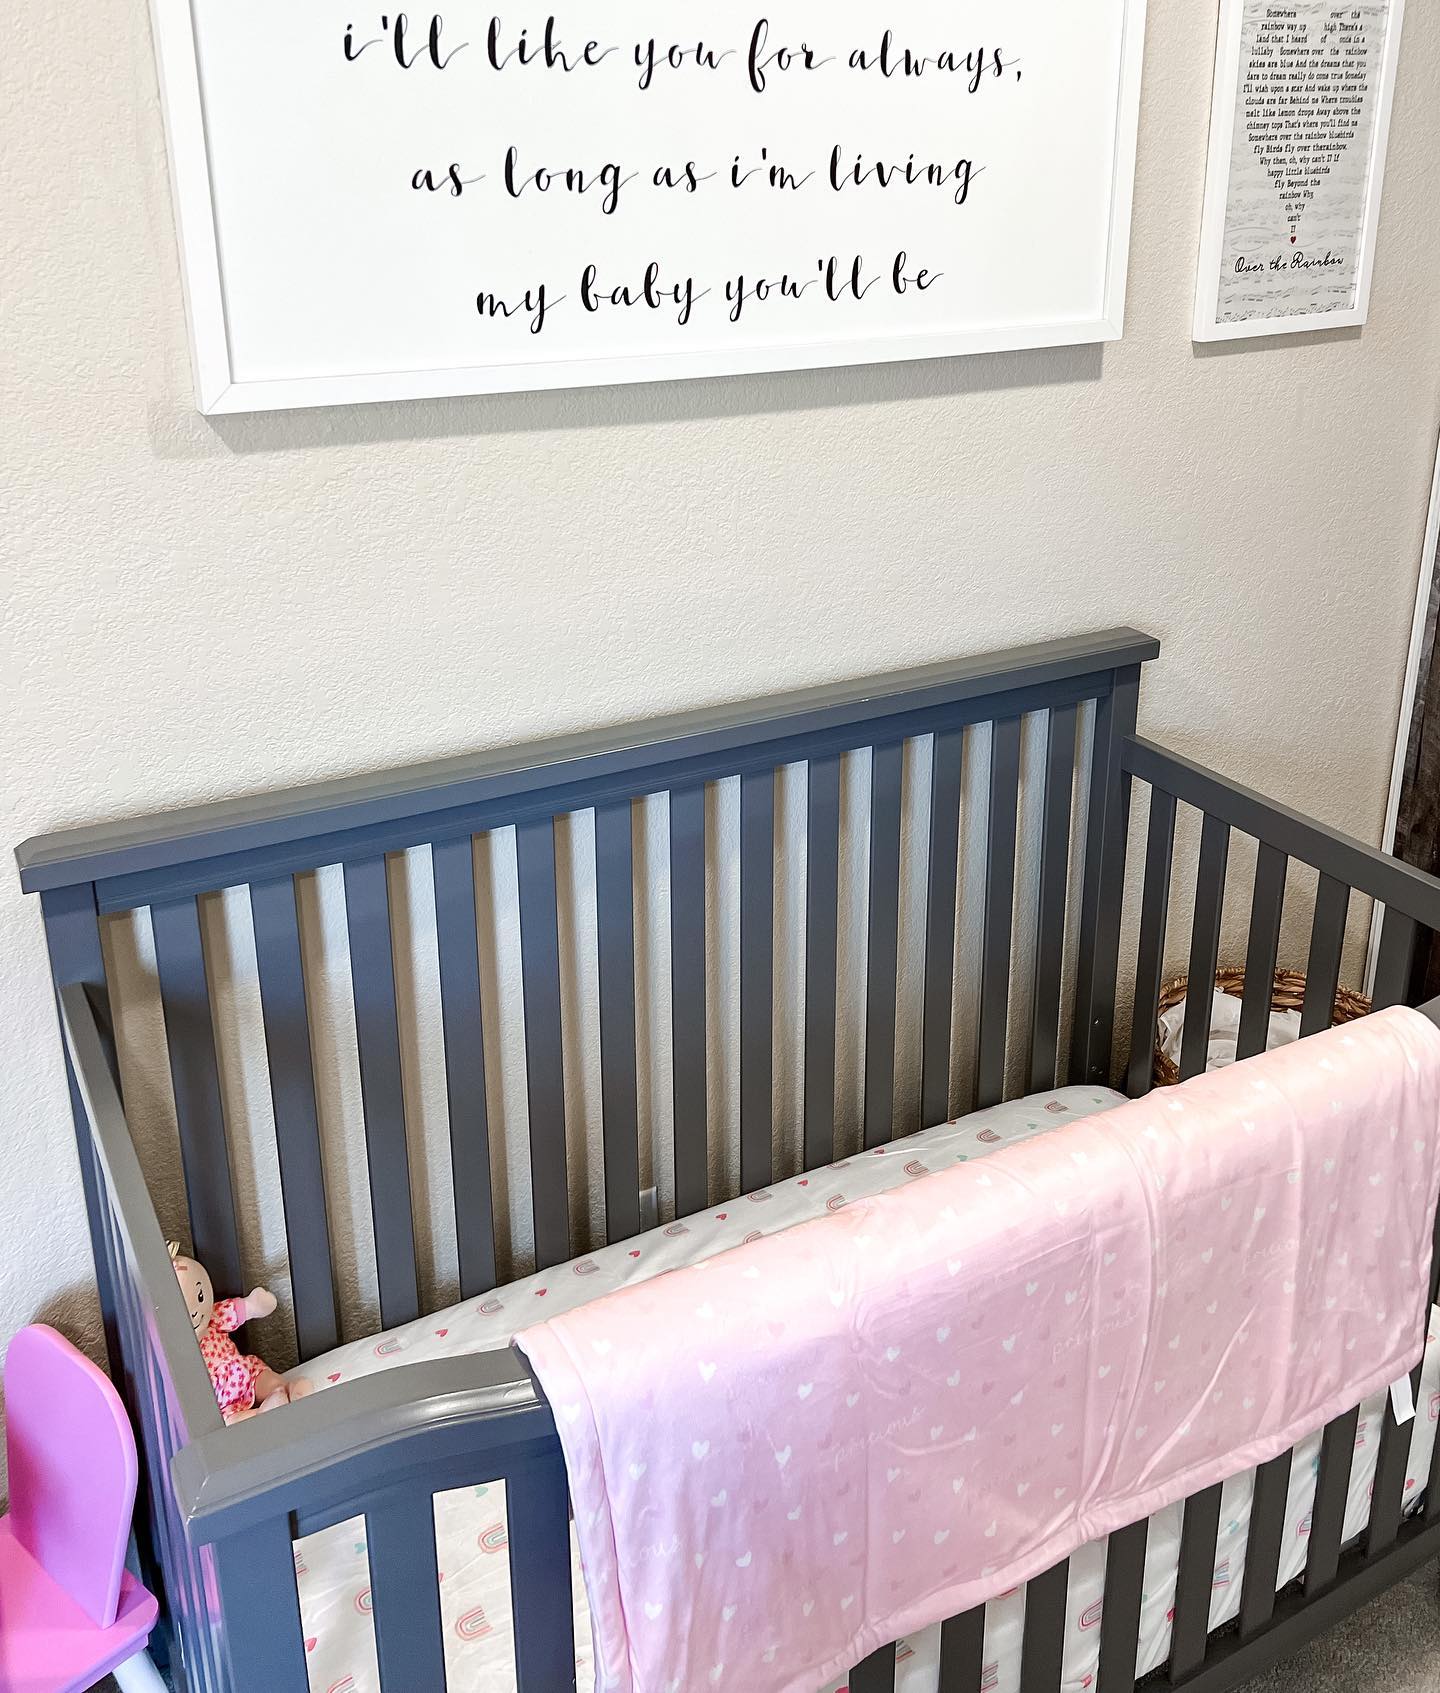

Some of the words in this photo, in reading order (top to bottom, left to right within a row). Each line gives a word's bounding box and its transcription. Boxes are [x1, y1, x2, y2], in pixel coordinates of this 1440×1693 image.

[344, 13, 469, 70] i'll
[487, 16, 620, 72] like
[633, 38, 738, 92] you
[747, 18, 836, 93] for
[847, 30, 1023, 93] always,
[412, 161, 486, 196] as
[503, 145, 639, 214] long
[652, 162, 717, 192] as
[730, 148, 816, 190] i'm
[828, 144, 987, 204] living
[476, 284, 567, 334] my
[580, 262, 711, 326] baby
[725, 255, 881, 321] you'll
[892, 251, 945, 294] be
[1234, 256, 1265, 273] Over
[1269, 255, 1288, 272] the
[1290, 250, 1345, 270] Rainbow
